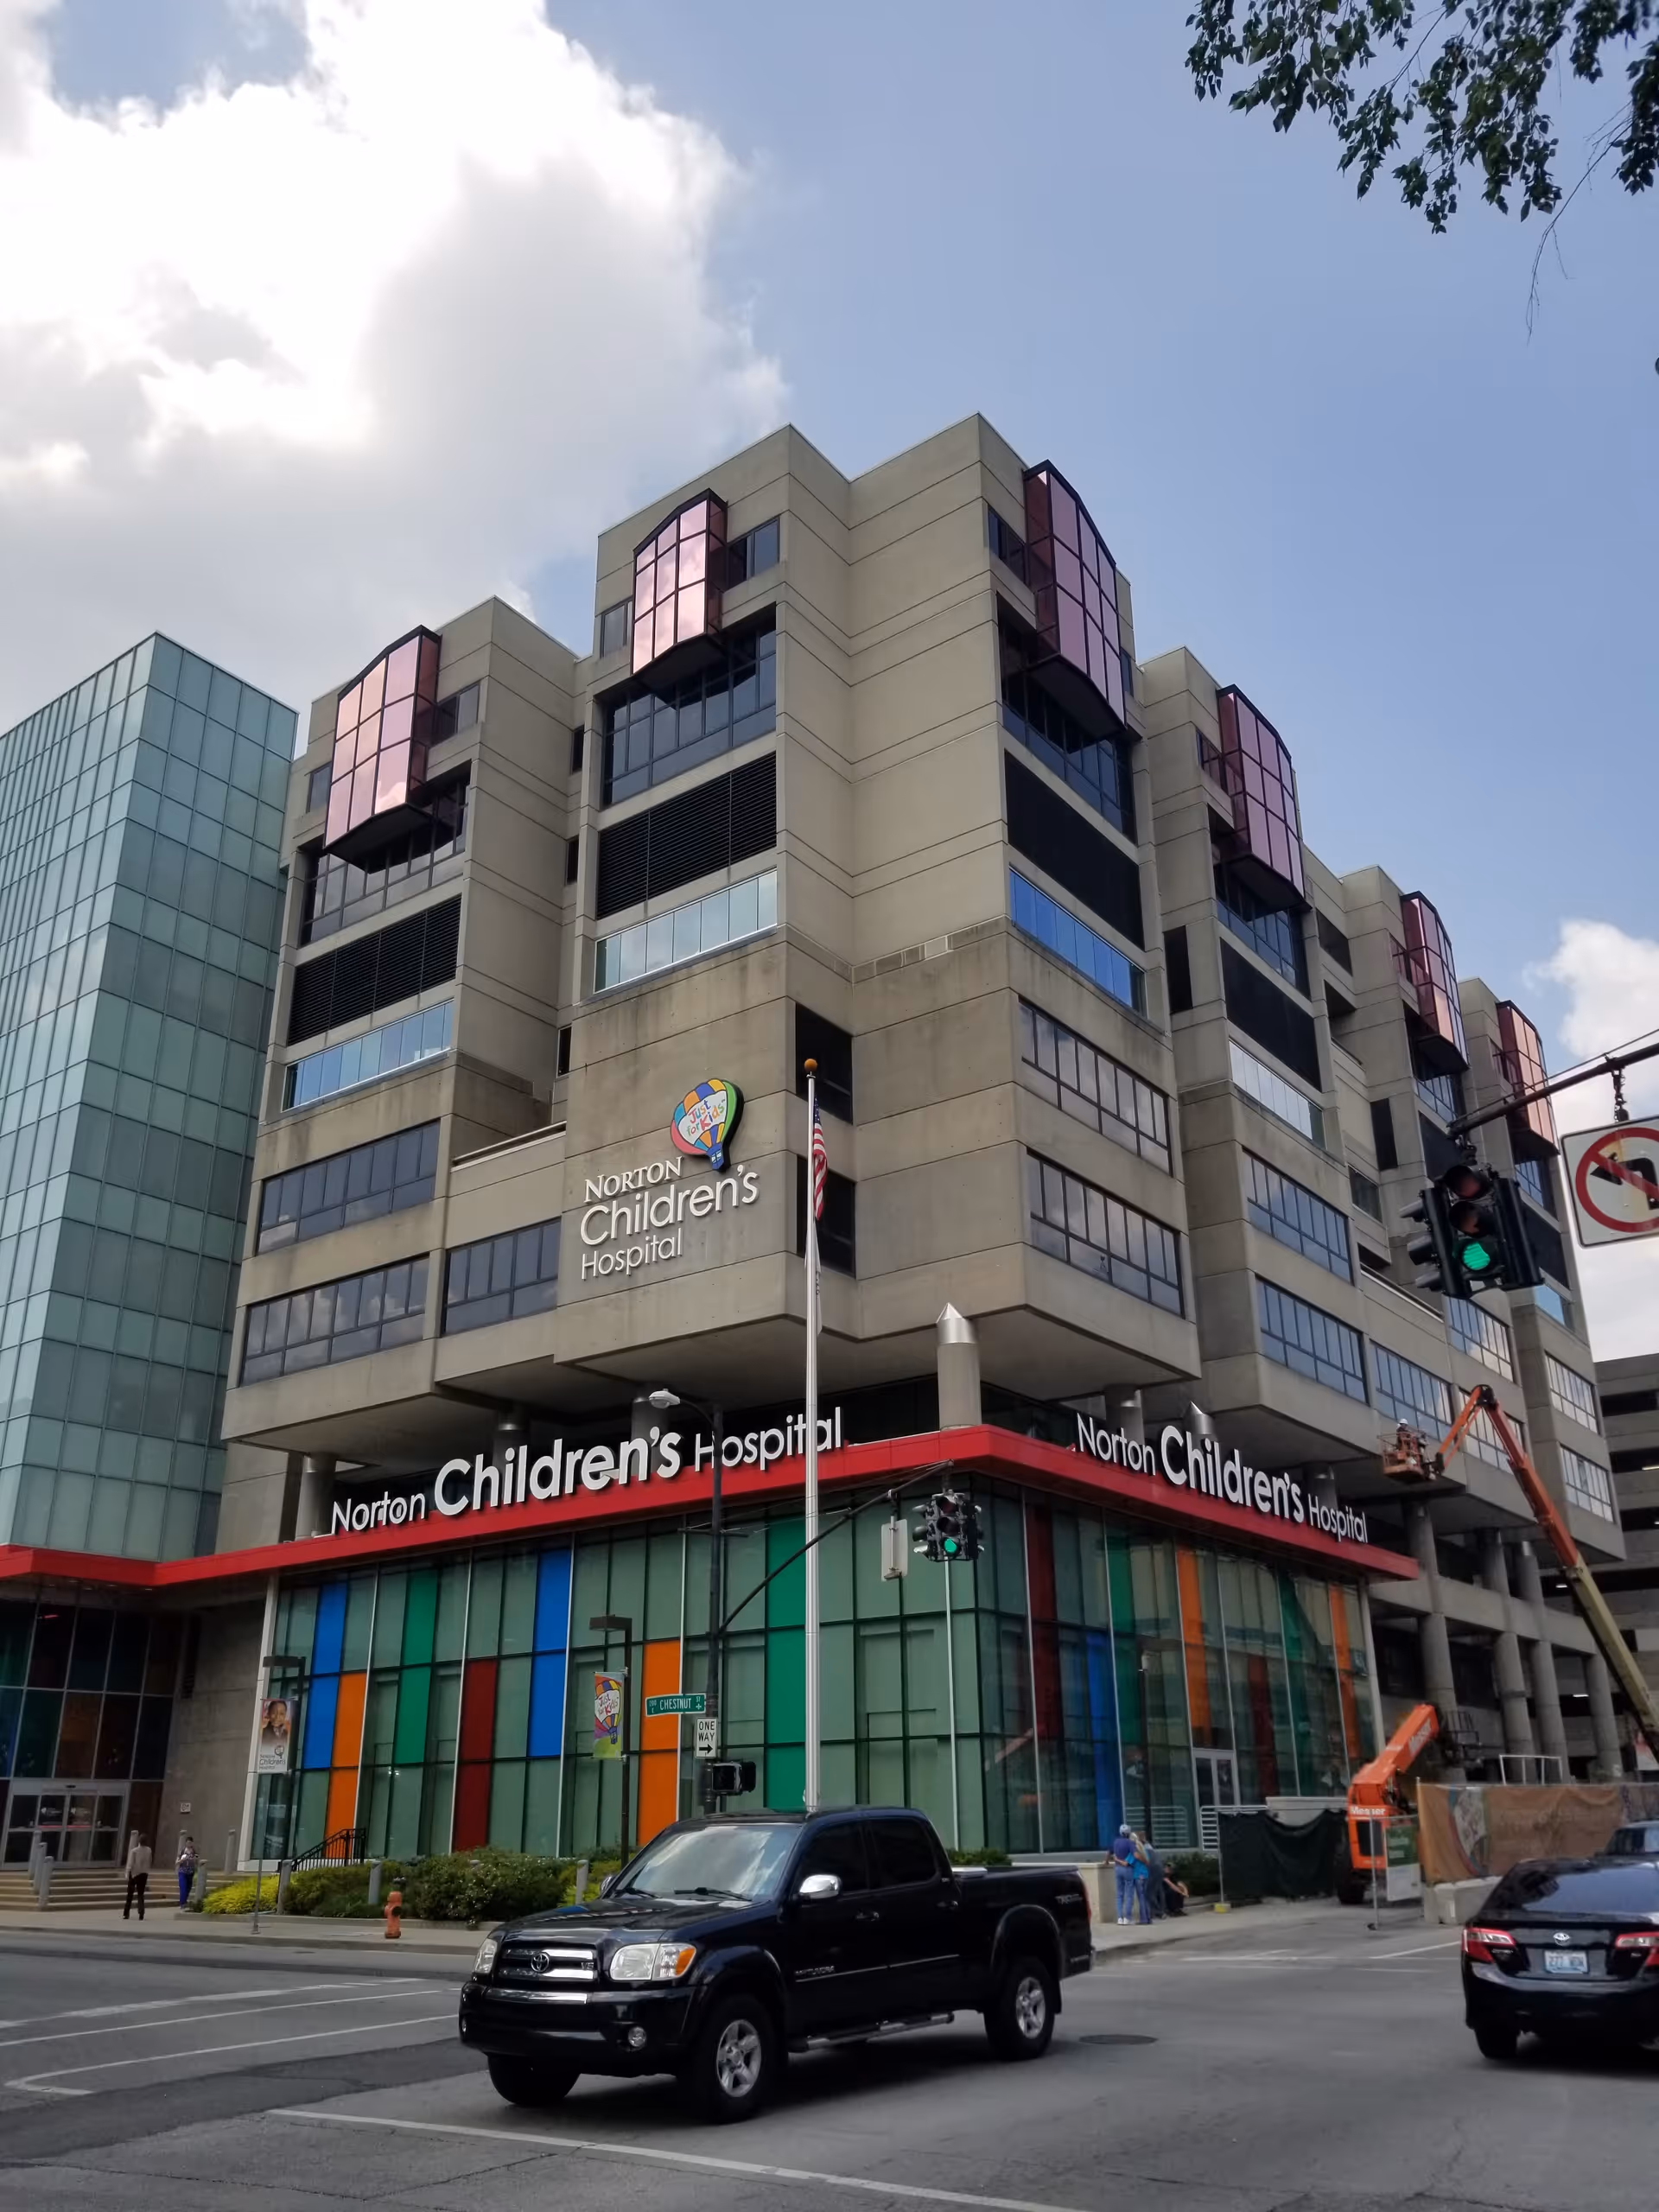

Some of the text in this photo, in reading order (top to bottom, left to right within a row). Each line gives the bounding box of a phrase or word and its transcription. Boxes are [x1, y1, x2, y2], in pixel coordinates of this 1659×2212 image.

[686, 1103, 725, 1137] for Kids
[688, 1099, 711, 1123] Just
[584, 1156, 684, 1204] NORTON
[581, 1165, 760, 1246] Children's
[582, 1228, 683, 1281] Hospital
[331, 1407, 842, 1535] Norton Children's Hospital
[1077, 1412, 1369, 1544] Norton Children's Hospital
[659, 1698, 692, 1710] CHESTNUT
[698, 1721, 715, 1731] ONE
[698, 1732, 715, 1742] WAY
